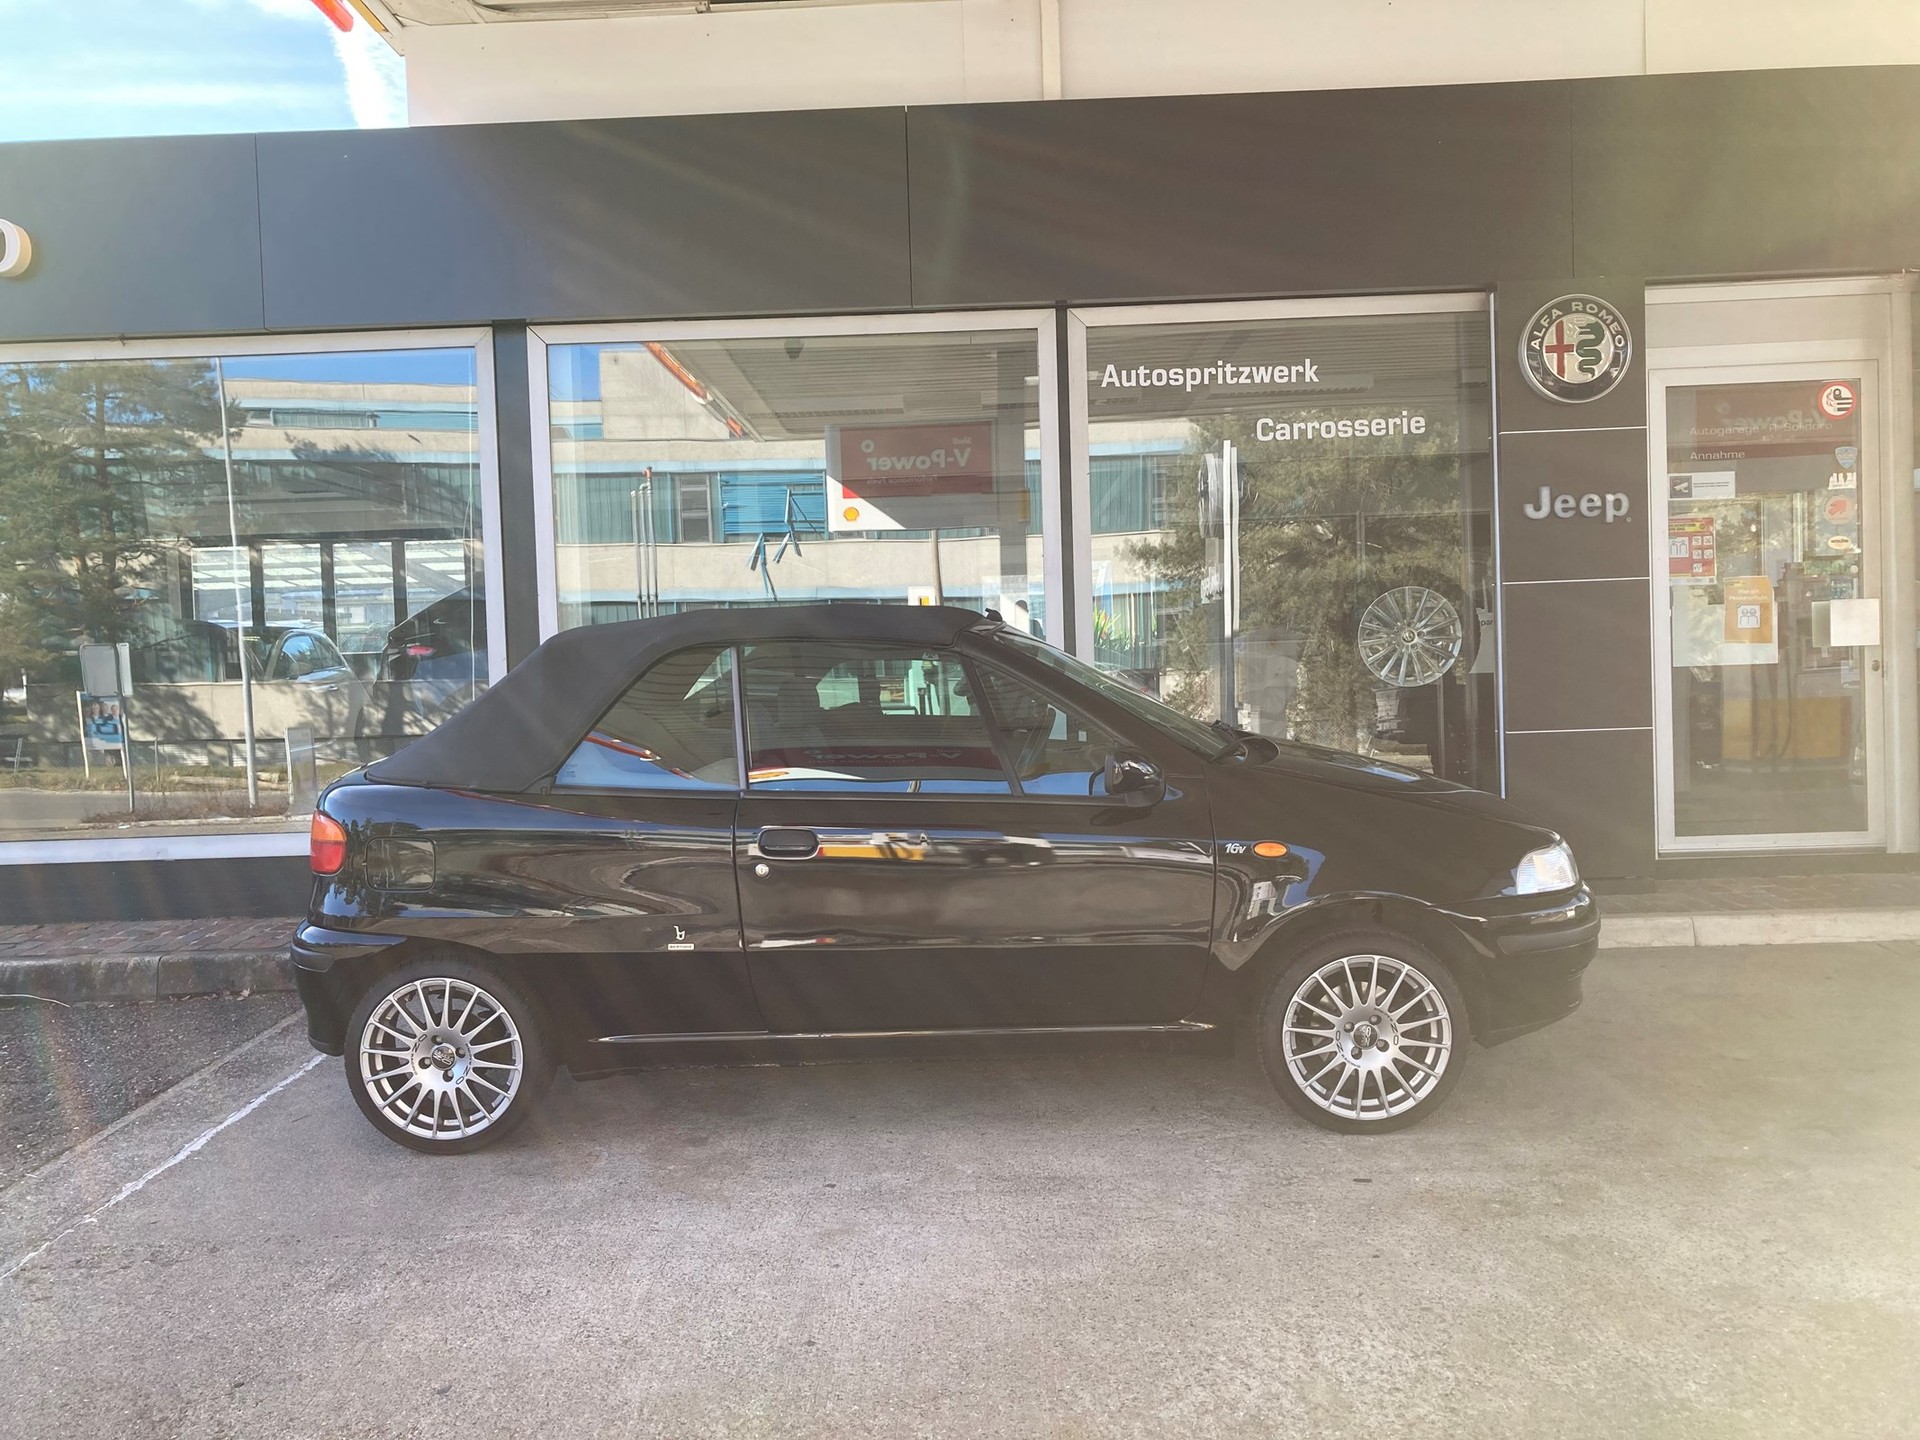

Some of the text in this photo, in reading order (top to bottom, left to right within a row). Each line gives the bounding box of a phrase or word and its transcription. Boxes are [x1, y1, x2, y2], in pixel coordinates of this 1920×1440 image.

[1530, 301, 1625, 350] ALFA ROMEO
[1101, 359, 1319, 392] Autospritzwerk
[1256, 410, 1426, 441] Carrosserie
[1690, 425, 1759, 436] Autogarage
[1690, 450, 1746, 461] Annahme
[1523, 485, 1630, 524] Jeep
[1225, 843, 1247, 854] 16v
